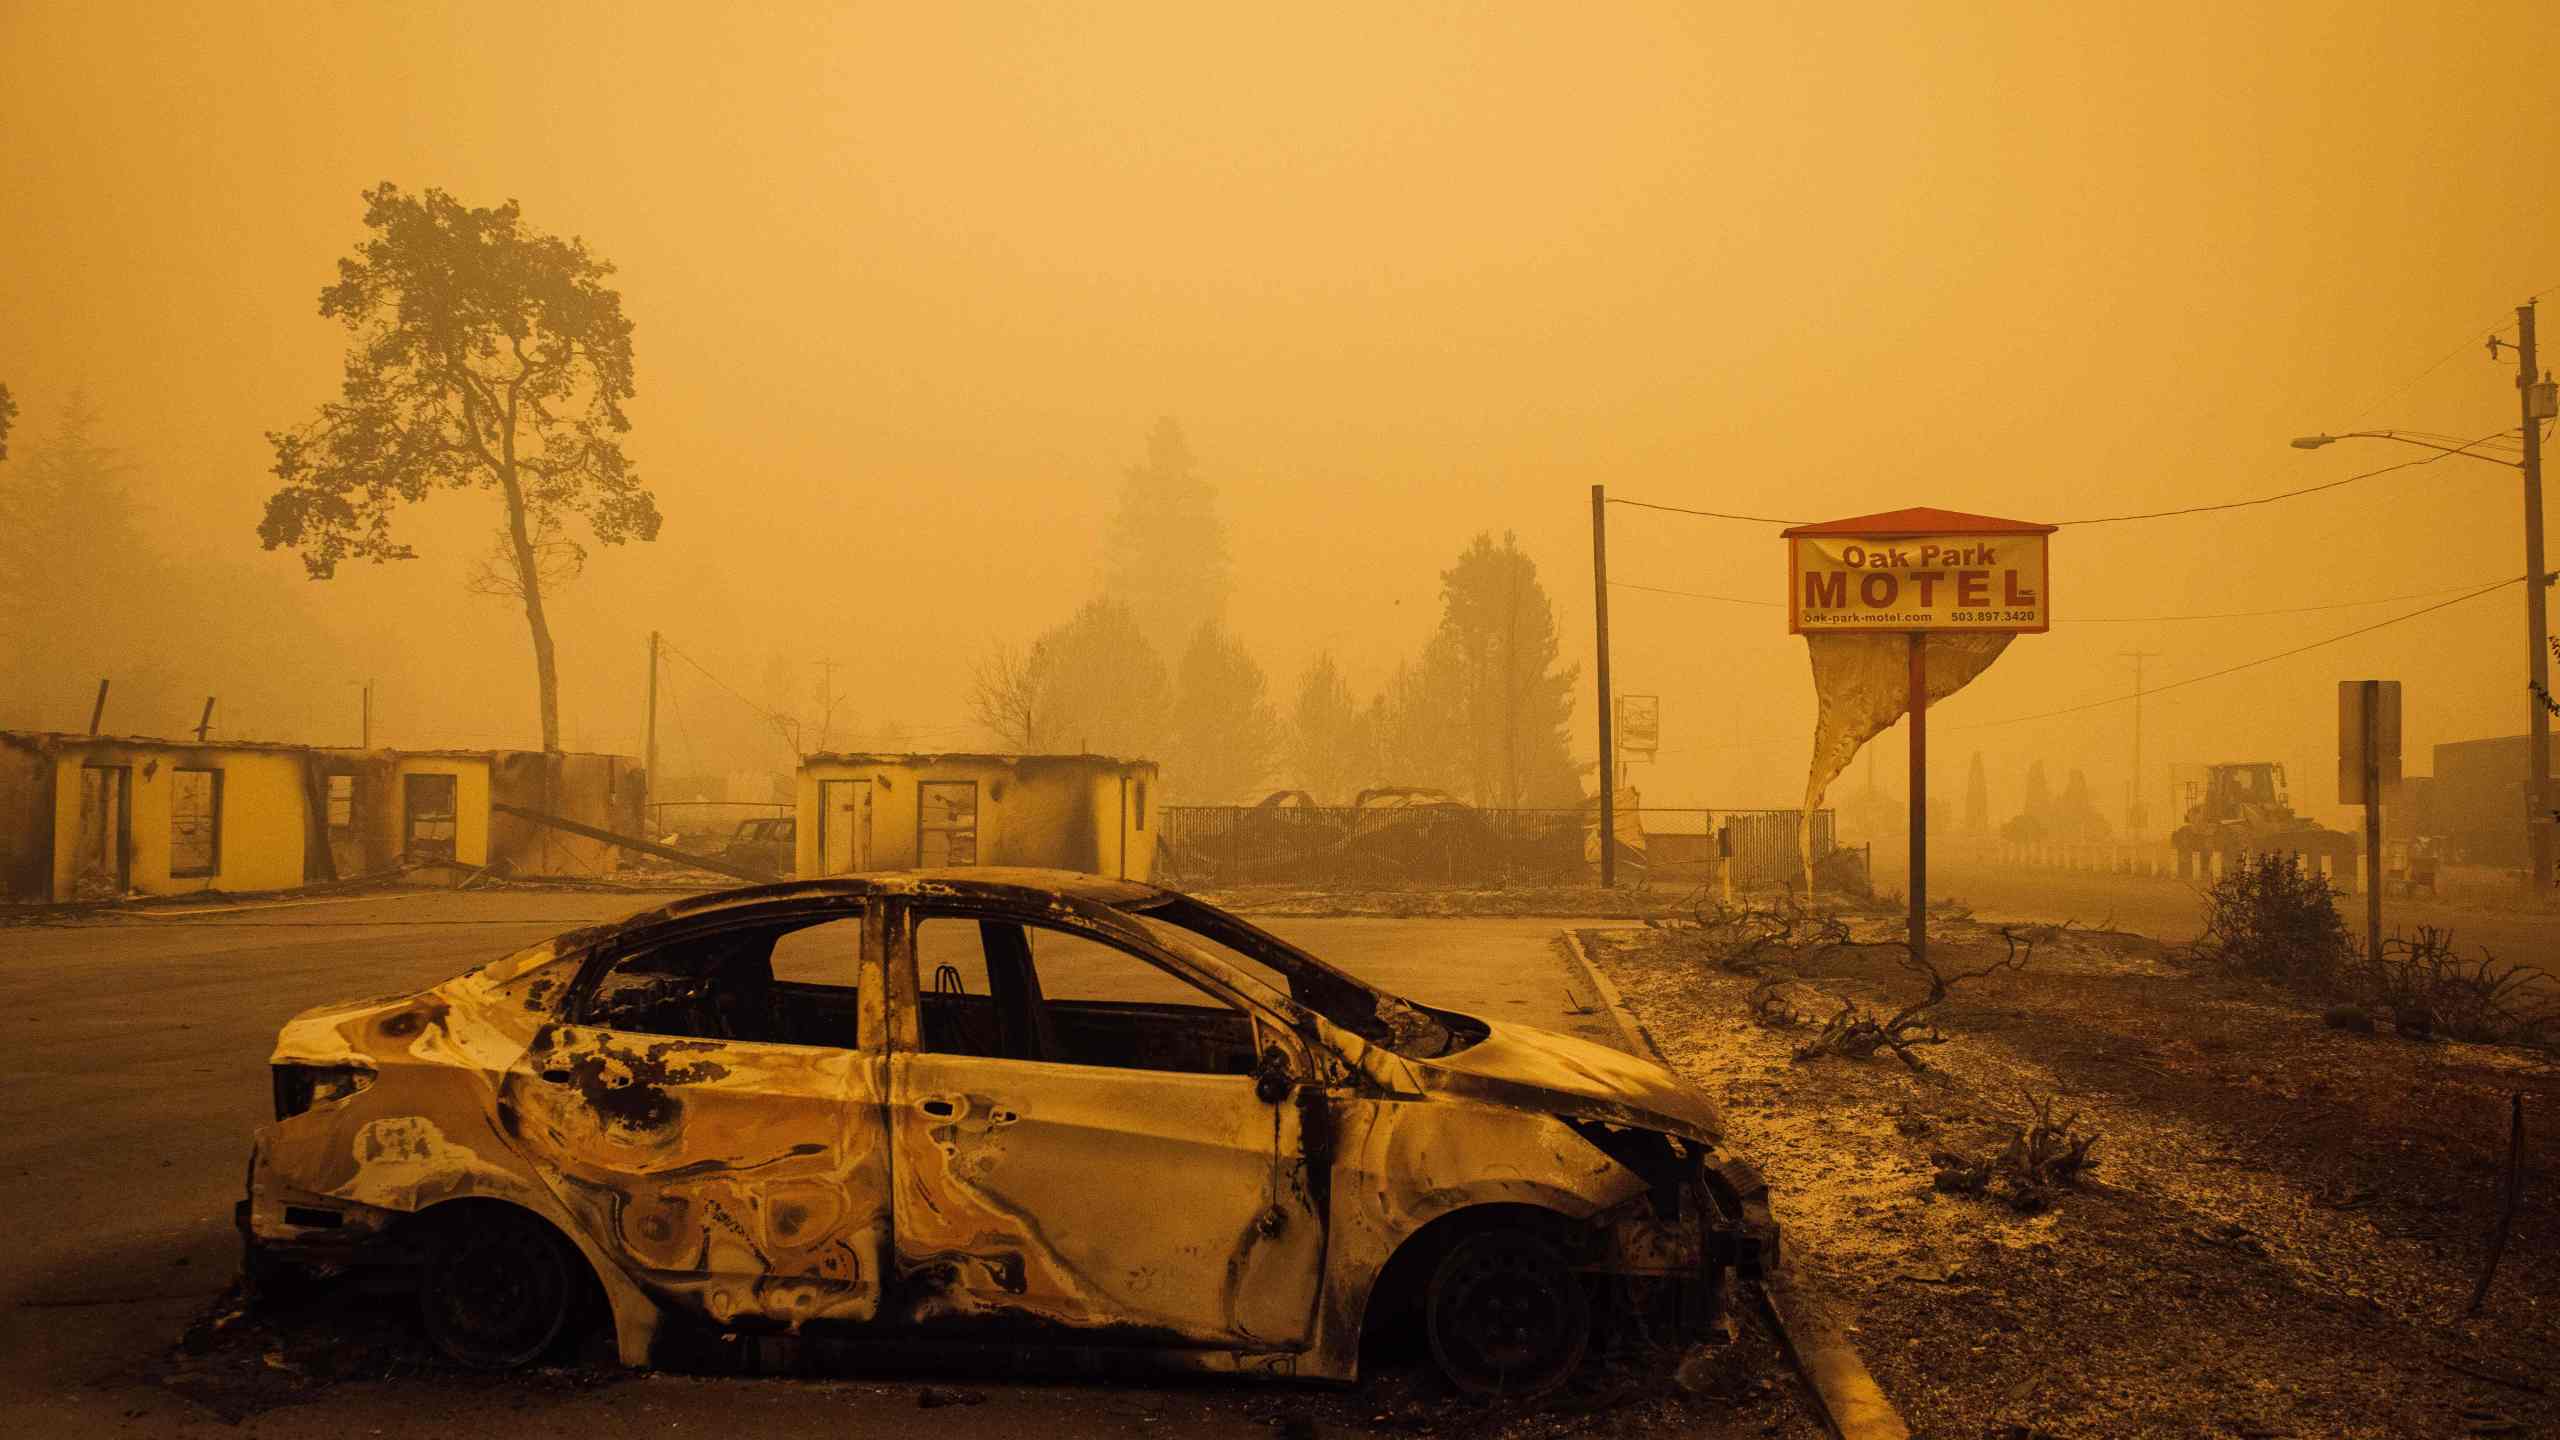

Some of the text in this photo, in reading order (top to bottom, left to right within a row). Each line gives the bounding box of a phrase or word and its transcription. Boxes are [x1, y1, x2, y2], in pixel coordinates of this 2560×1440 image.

[1843, 544, 1996, 568] Oak Park
[1805, 570, 2035, 608] MOTEL
[1804, 611, 2034, 623] oak-park-motel.com 503.897.3420
